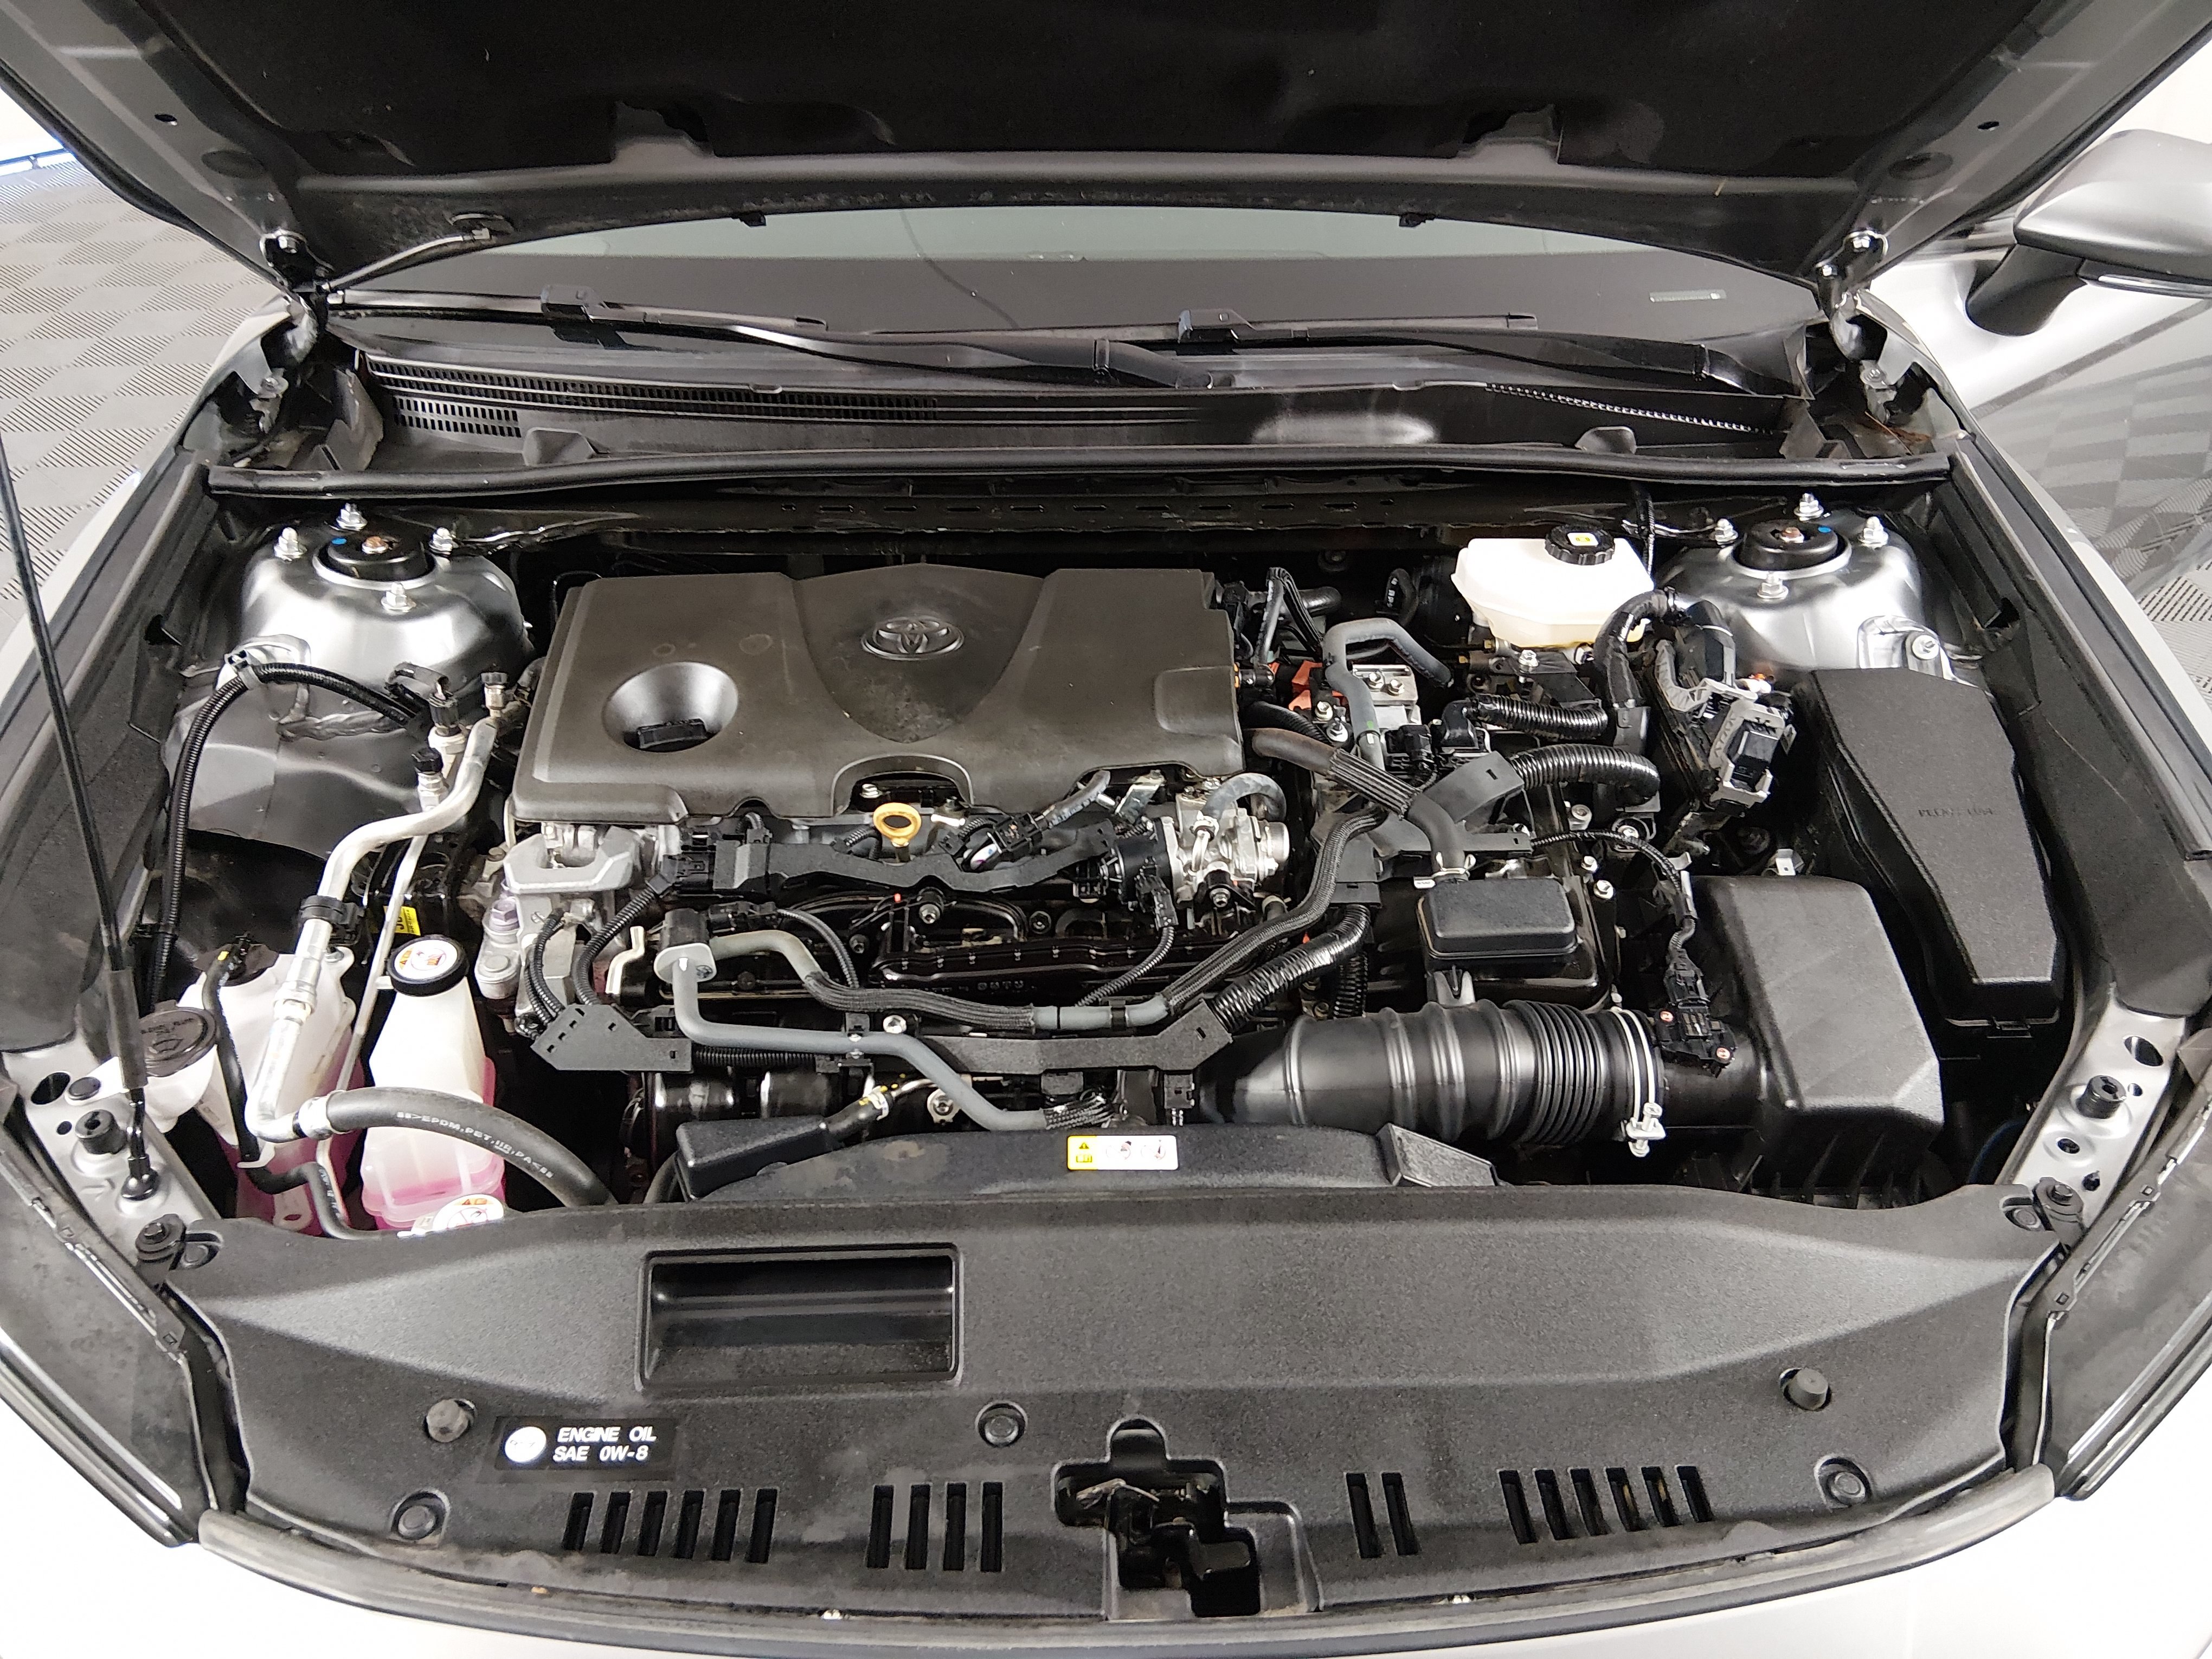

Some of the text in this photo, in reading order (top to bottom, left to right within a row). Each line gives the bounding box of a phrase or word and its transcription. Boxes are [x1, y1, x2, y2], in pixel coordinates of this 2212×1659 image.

[557, 1426, 657, 1443] ENGINE OIL
[552, 1445, 649, 1462] SAE 0W-8
